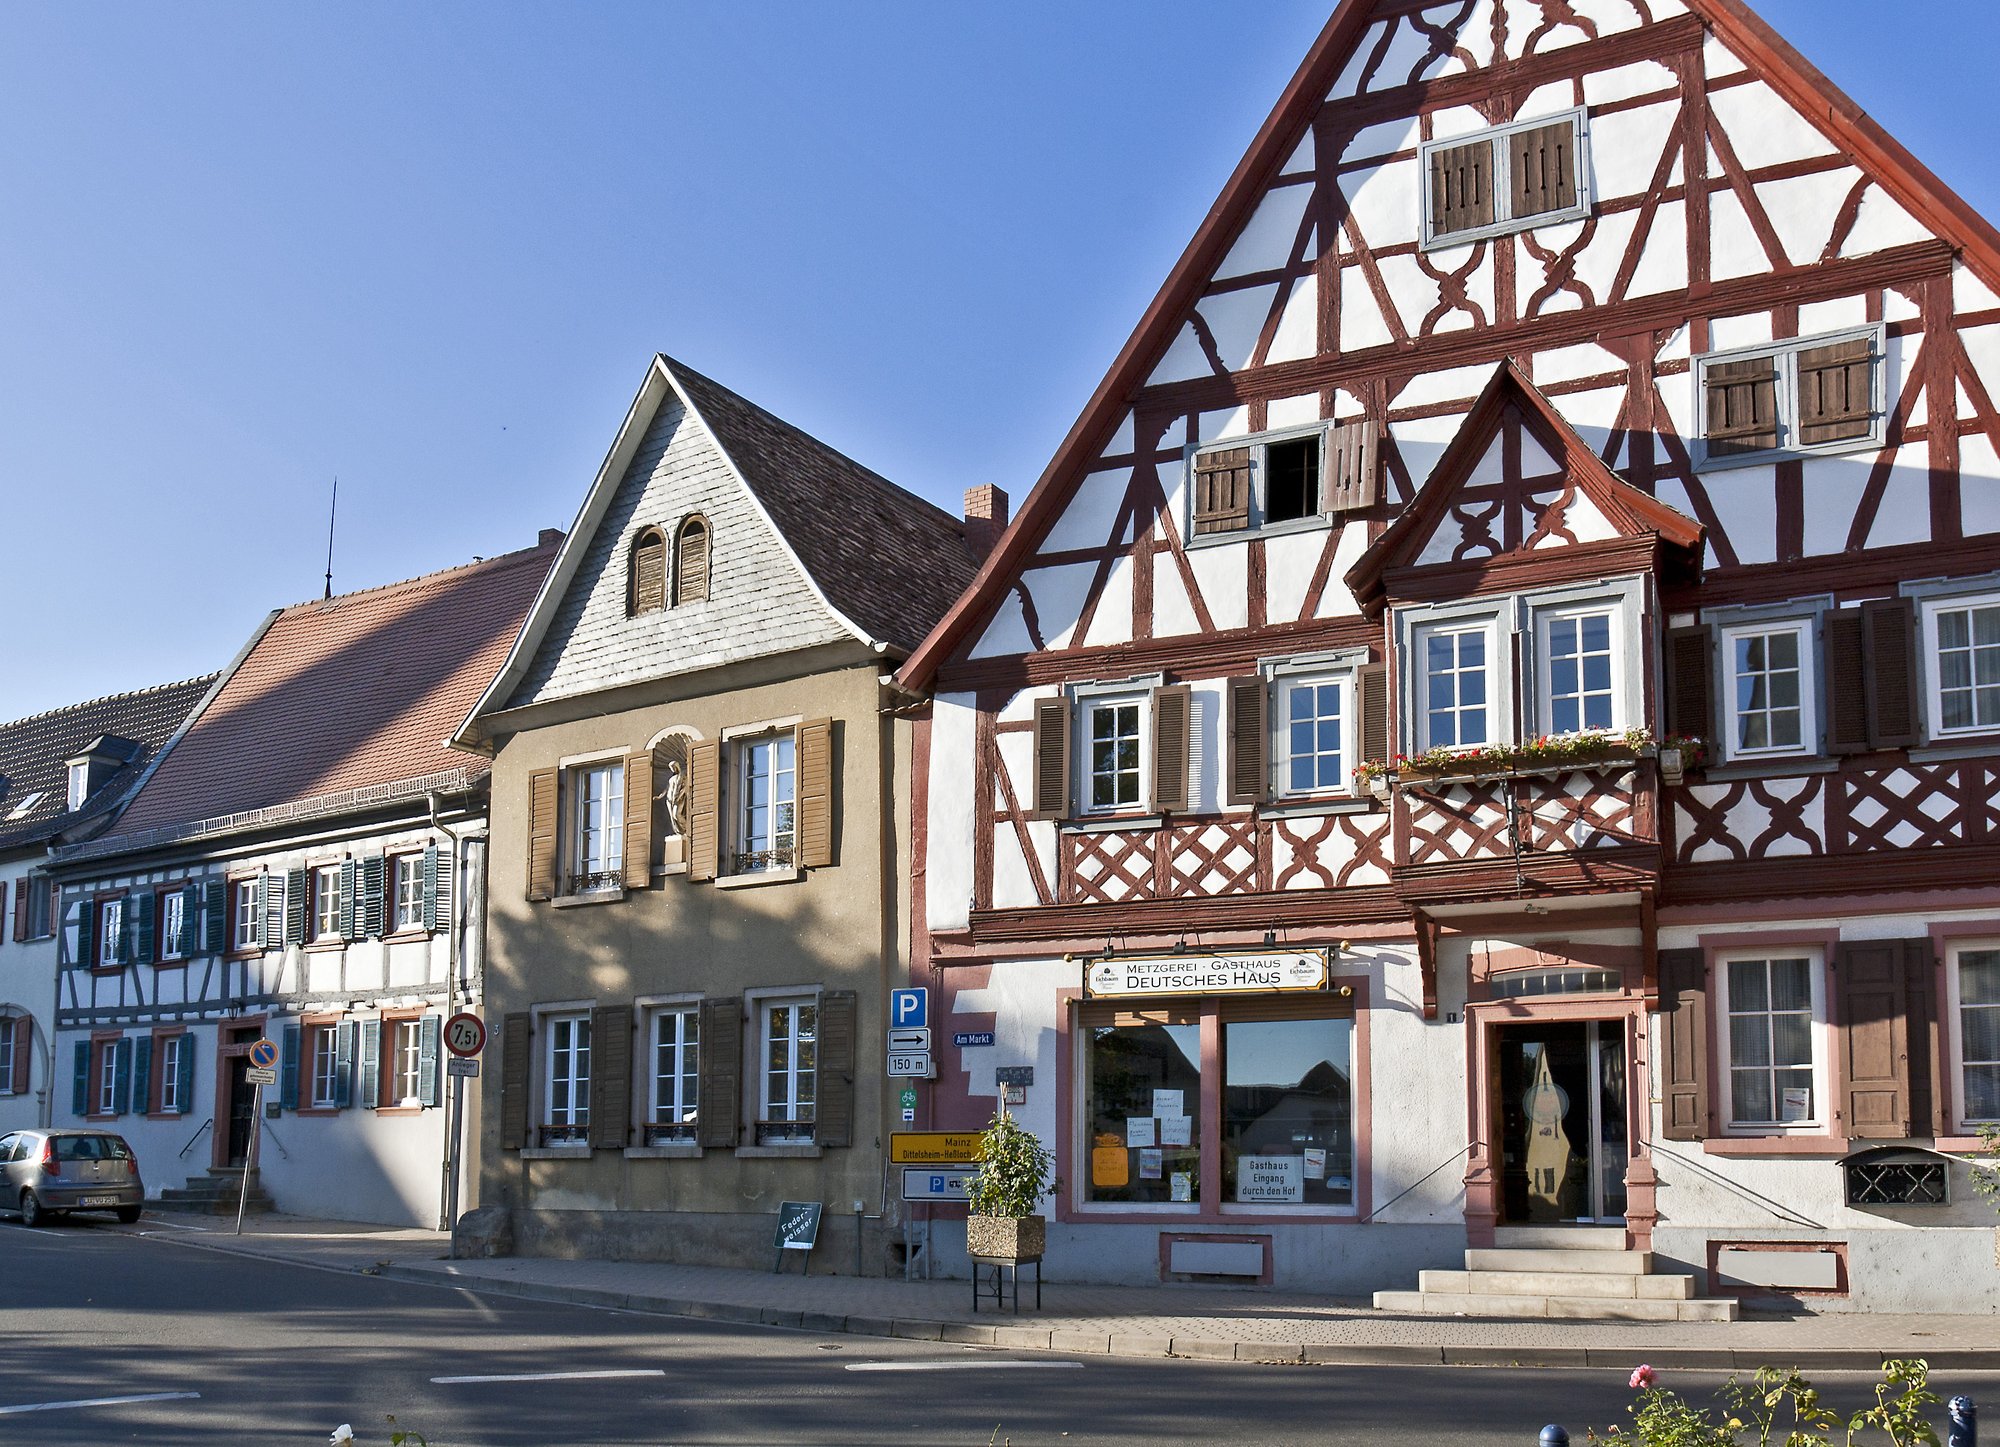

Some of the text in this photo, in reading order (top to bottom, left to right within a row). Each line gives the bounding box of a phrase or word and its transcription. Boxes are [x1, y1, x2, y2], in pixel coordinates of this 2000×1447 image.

[1127, 960, 1281, 973] METZGEREI GASTHAUS
[1127, 974, 1228, 989] DEUTSCHES
[1234, 971, 1281, 984] HAUS
[900, 994, 919, 1023] P
[956, 1034, 990, 1044] Am Markt
[893, 1059, 923, 1070] 150 m
[945, 1138, 971, 1146] Mainz
[1250, 1160, 1289, 1170] Gasthaus
[932, 1178, 942, 1190] P
[1253, 1173, 1285, 1184] Eingang
[1242, 1185, 1296, 1195] durch den Hof
